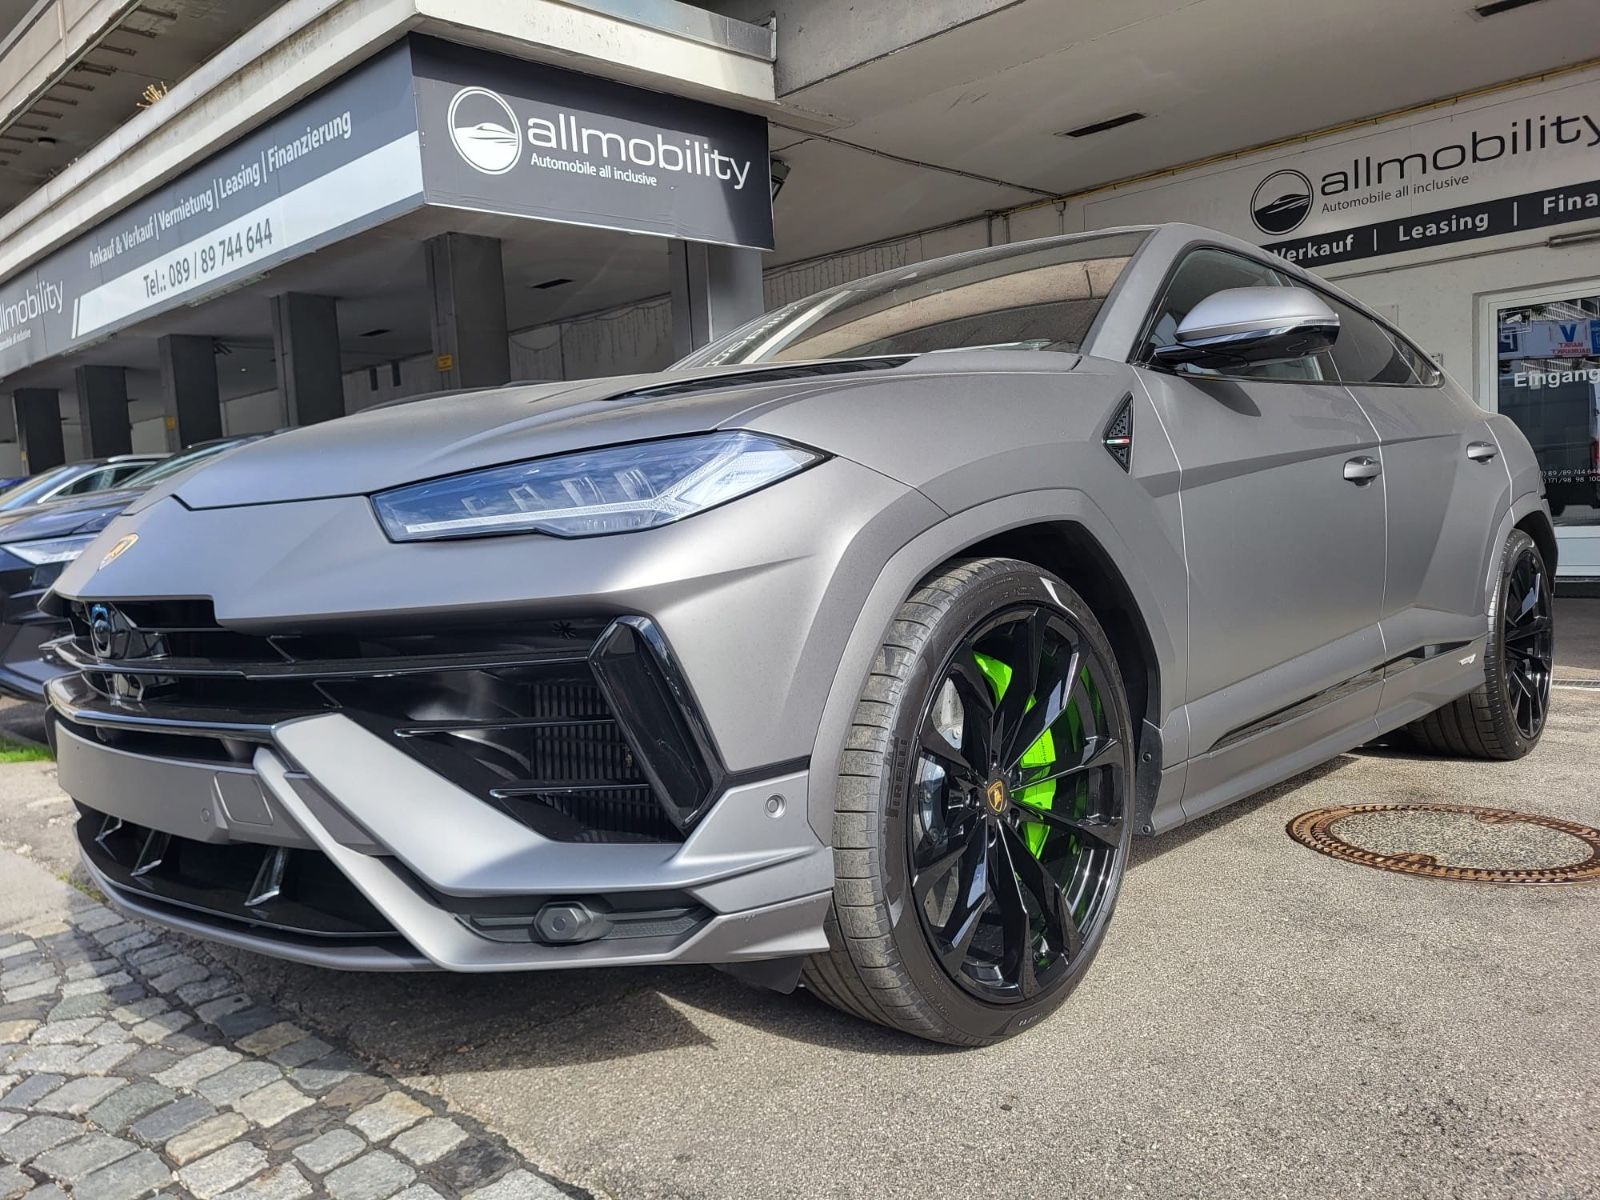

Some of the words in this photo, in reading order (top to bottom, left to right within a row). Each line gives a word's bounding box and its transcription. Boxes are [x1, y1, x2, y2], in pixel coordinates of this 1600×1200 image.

[527, 113, 751, 190] allmobility
[530, 153, 597, 177] Automobile
[599, 165, 612, 179] all
[613, 167, 657, 187] inclusive
[1320, 114, 1600, 196] allmobility
[89, 242, 116, 269] Ankauf
[115, 237, 123, 254] &
[122, 219, 154, 248] Verkauf
[157, 189, 213, 229] Vermietung
[219, 162, 261, 198] Leasing
[268, 111, 352, 172] Finanzierung
[1321, 189, 1392, 214] Automobile
[1394, 185, 1409, 199] all
[1413, 174, 1470, 195] inclusive
[1398, 212, 1489, 242] Leasing
[1543, 194, 1599, 215] Fina
[143, 274, 167, 299] Tel.:
[168, 260, 190, 287] 089
[200, 247, 216, 274] 89
[219, 236, 243, 266] 744
[246, 217, 273, 256] 644
[0, 280, 63, 335] llmobility
[1514, 368, 1600, 388] Eingang
